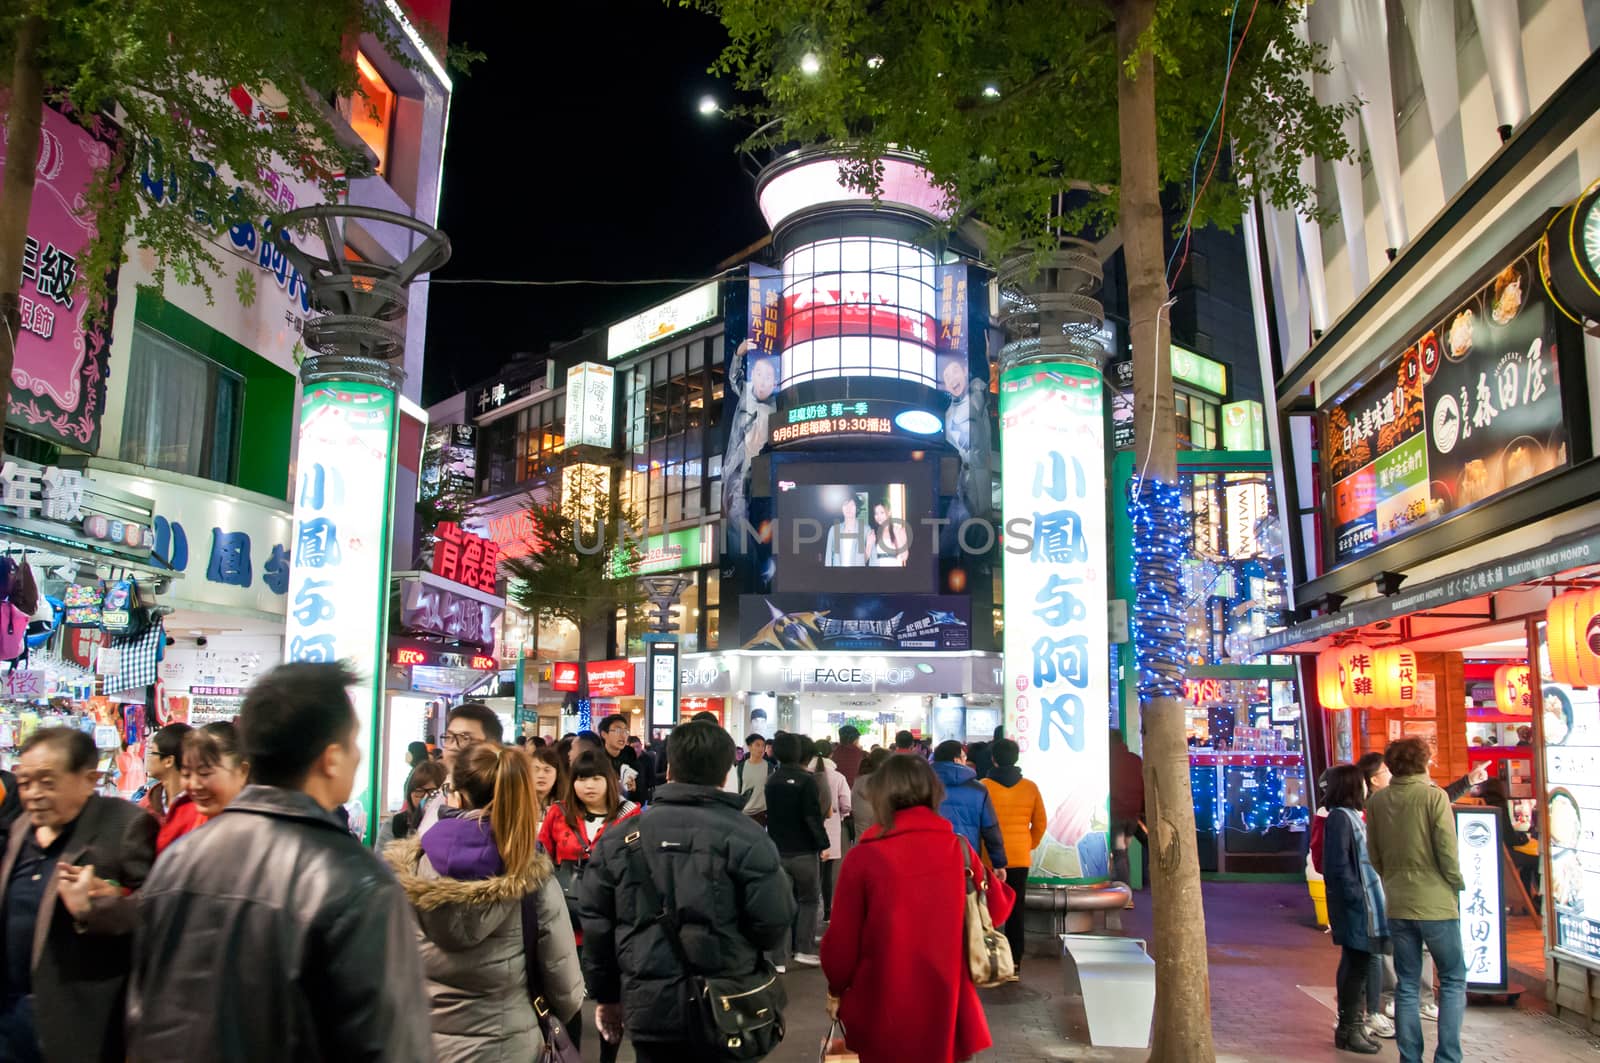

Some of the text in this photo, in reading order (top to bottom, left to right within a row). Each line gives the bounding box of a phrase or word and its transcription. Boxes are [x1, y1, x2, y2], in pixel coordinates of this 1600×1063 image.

[1472, 338, 1547, 428] 森田屋
[773, 418, 891, 442] 9月6日起每晚19:30播出
[831, 402, 868, 416] 第一季
[1342, 386, 1404, 451] 日本美味通り
[437, 521, 499, 595] 肯德基
[1508, 553, 1559, 577] BAKUDANYAKI
[1560, 545, 1590, 562] HONPO
[399, 651, 417, 664] KFC
[473, 657, 488, 668] KFC
[1350, 654, 1373, 696] 炸雞
[1399, 653, 1414, 700] 三代目
[1466, 888, 1493, 974] 森田屋
